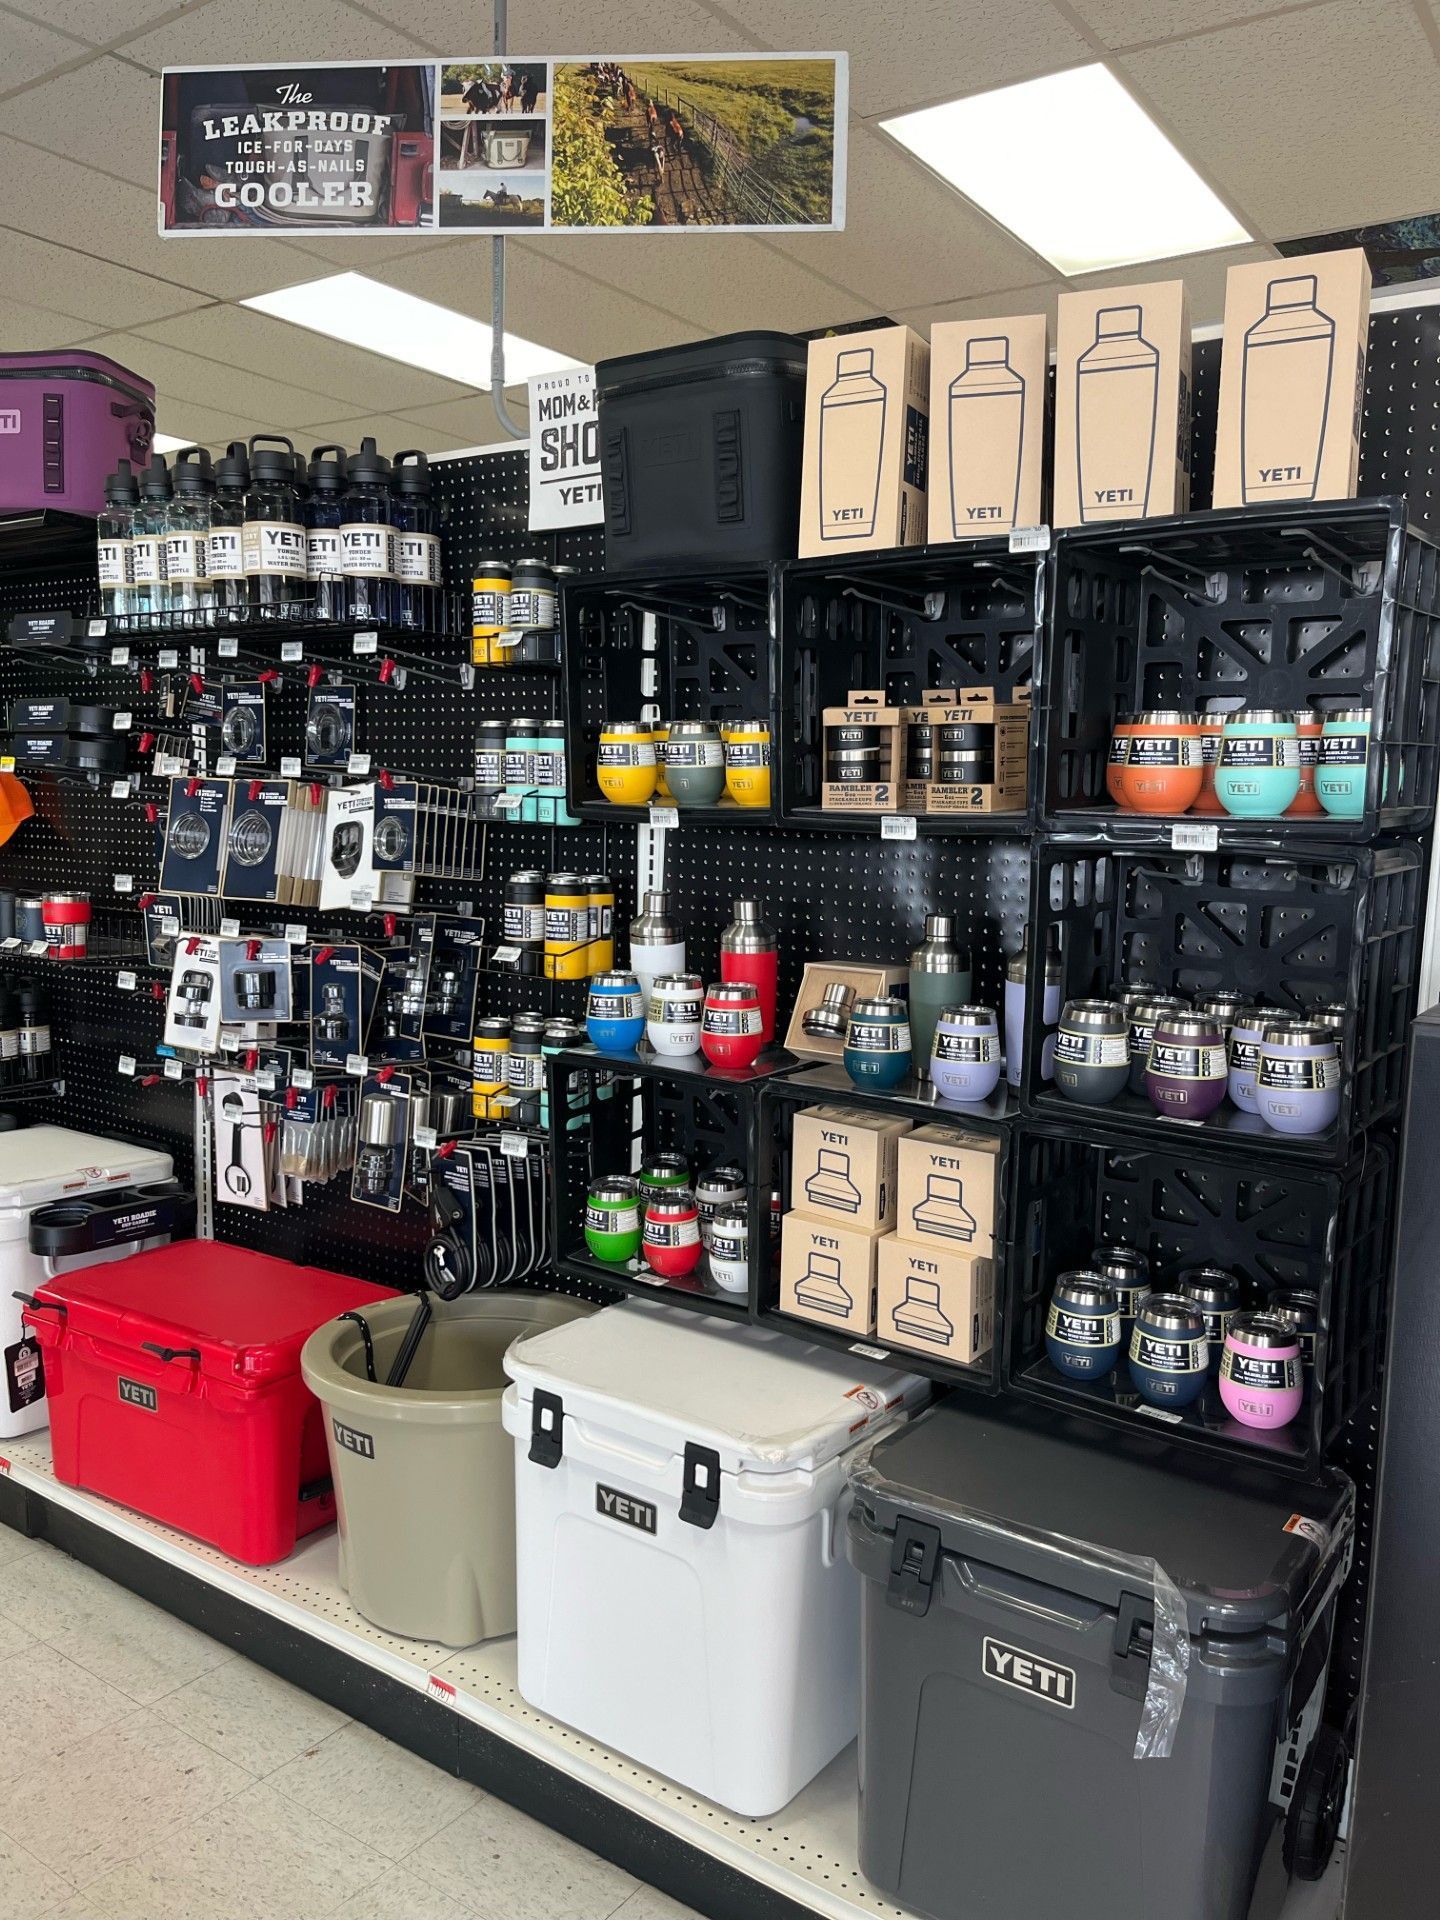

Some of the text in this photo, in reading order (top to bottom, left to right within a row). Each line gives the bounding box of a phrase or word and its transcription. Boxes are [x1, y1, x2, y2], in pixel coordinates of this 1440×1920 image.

[276, 83, 313, 104] The
[203, 111, 391, 141] LEAKPROOF
[237, 139, 354, 155] ICE-FOR-DAYS
[226, 159, 365, 174] TOUGH-AS-NAILS
[215, 180, 374, 208] COOLER
[538, 375, 590, 391] PROUD TO
[0, 414, 16, 428] TI
[540, 419, 600, 472] SHO
[1259, 466, 1301, 482] YETI
[559, 483, 602, 506] YETI
[1094, 489, 1133, 502] YETI
[832, 508, 864, 520] YETI
[966, 506, 1002, 519] YETI
[212, 536, 235, 550] ETI
[266, 530, 304, 548] YETI
[342, 532, 380, 548] YETI
[133, 544, 150, 558] ETI
[168, 540, 188, 554] ETI
[400, 542, 422, 556] ETI
[98, 546, 116, 561] ETI
[513, 594, 530, 604] ETI
[844, 711, 878, 723] YETI
[912, 712, 928, 723] YE
[944, 710, 974, 721] YETI
[840, 731, 862, 740] YETI
[943, 730, 961, 740] YETI
[600, 745, 623, 754] YETI
[654, 742, 667, 750] ETI
[668, 745, 690, 754] YETI
[1114, 740, 1127, 750] YE
[1135, 740, 1172, 751] YETI
[1227, 740, 1264, 751] YETI
[1323, 738, 1357, 749] YETI
[730, 745, 753, 755] YETI
[476, 754, 498, 764] YETI
[539, 756, 551, 765] ETI
[840, 768, 861, 778] YETI
[943, 770, 961, 778] YETI
[1135, 782, 1162, 792] YETI
[1230, 783, 1257, 793] YETI
[1322, 783, 1350, 792] YETI
[875, 785, 889, 802] 2
[970, 787, 984, 805] 2
[337, 800, 355, 810] YETI
[152, 905, 172, 914] YETI
[546, 912, 568, 922] YETI
[45, 926, 61, 935] ETI
[444, 928, 460, 938] YETI
[194, 949, 208, 957] ETI
[592, 998, 618, 1007] YETI
[669, 1003, 696, 1012] YETI
[707, 1011, 733, 1022] YETI
[854, 1026, 882, 1038] YETI
[1134, 1026, 1152, 1039] YE
[942, 1036, 975, 1048] YETI
[1057, 1032, 1085, 1048] YETI
[1156, 1046, 1190, 1062] YETI
[1236, 1043, 1260, 1056] YE
[510, 1058, 524, 1068] ETI
[855, 1063, 878, 1072] YETI
[1266, 1059, 1304, 1074] YETI
[944, 1074, 968, 1084] YETI
[1157, 1090, 1184, 1102] YETI
[1240, 1086, 1254, 1097] YE
[1270, 1104, 1300, 1115] YETI
[820, 1130, 848, 1146] YETI
[930, 1155, 960, 1170] YETI
[456, 1166, 468, 1174] YETI
[639, 1183, 652, 1194] YET
[698, 1204, 713, 1213] ETI
[113, 1210, 157, 1225] YETI ROADIE
[645, 1221, 665, 1234] YETI
[712, 1236, 734, 1249] YETI
[811, 1234, 838, 1250] YETI
[909, 1258, 938, 1274] YETI
[714, 1272, 731, 1281] YETI
[1062, 1315, 1097, 1331] YETI
[1146, 1339, 1182, 1356] YETI
[1064, 1355, 1091, 1368] YETI
[1237, 1356, 1276, 1374] YETI
[1148, 1381, 1176, 1394] YETI
[120, 1382, 155, 1406] YETI
[1241, 1401, 1271, 1415] YETI
[334, 1422, 370, 1455] YETI
[600, 1489, 652, 1528] YETI
[988, 1646, 1070, 1700] YETI
